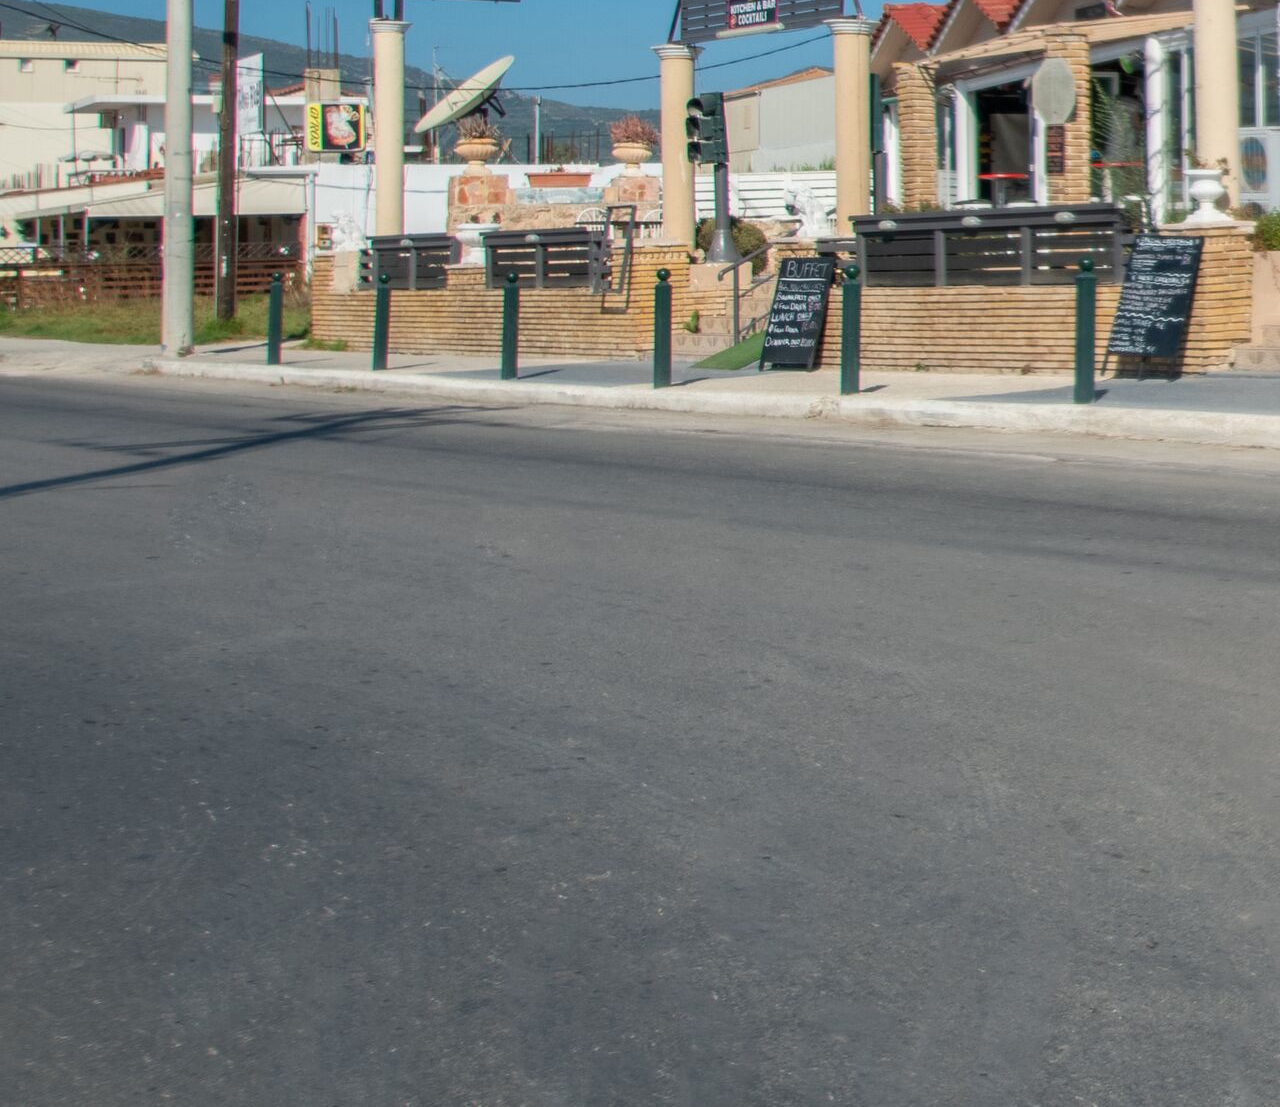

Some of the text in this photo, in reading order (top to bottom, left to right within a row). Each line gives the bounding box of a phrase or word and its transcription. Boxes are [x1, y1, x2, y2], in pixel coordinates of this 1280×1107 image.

[730, 1, 756, 15] KITCHEN
[738, 11, 767, 25] COCKTAILS
[309, 107, 320, 148] GYROS
[786, 260, 830, 278] BUFFET
